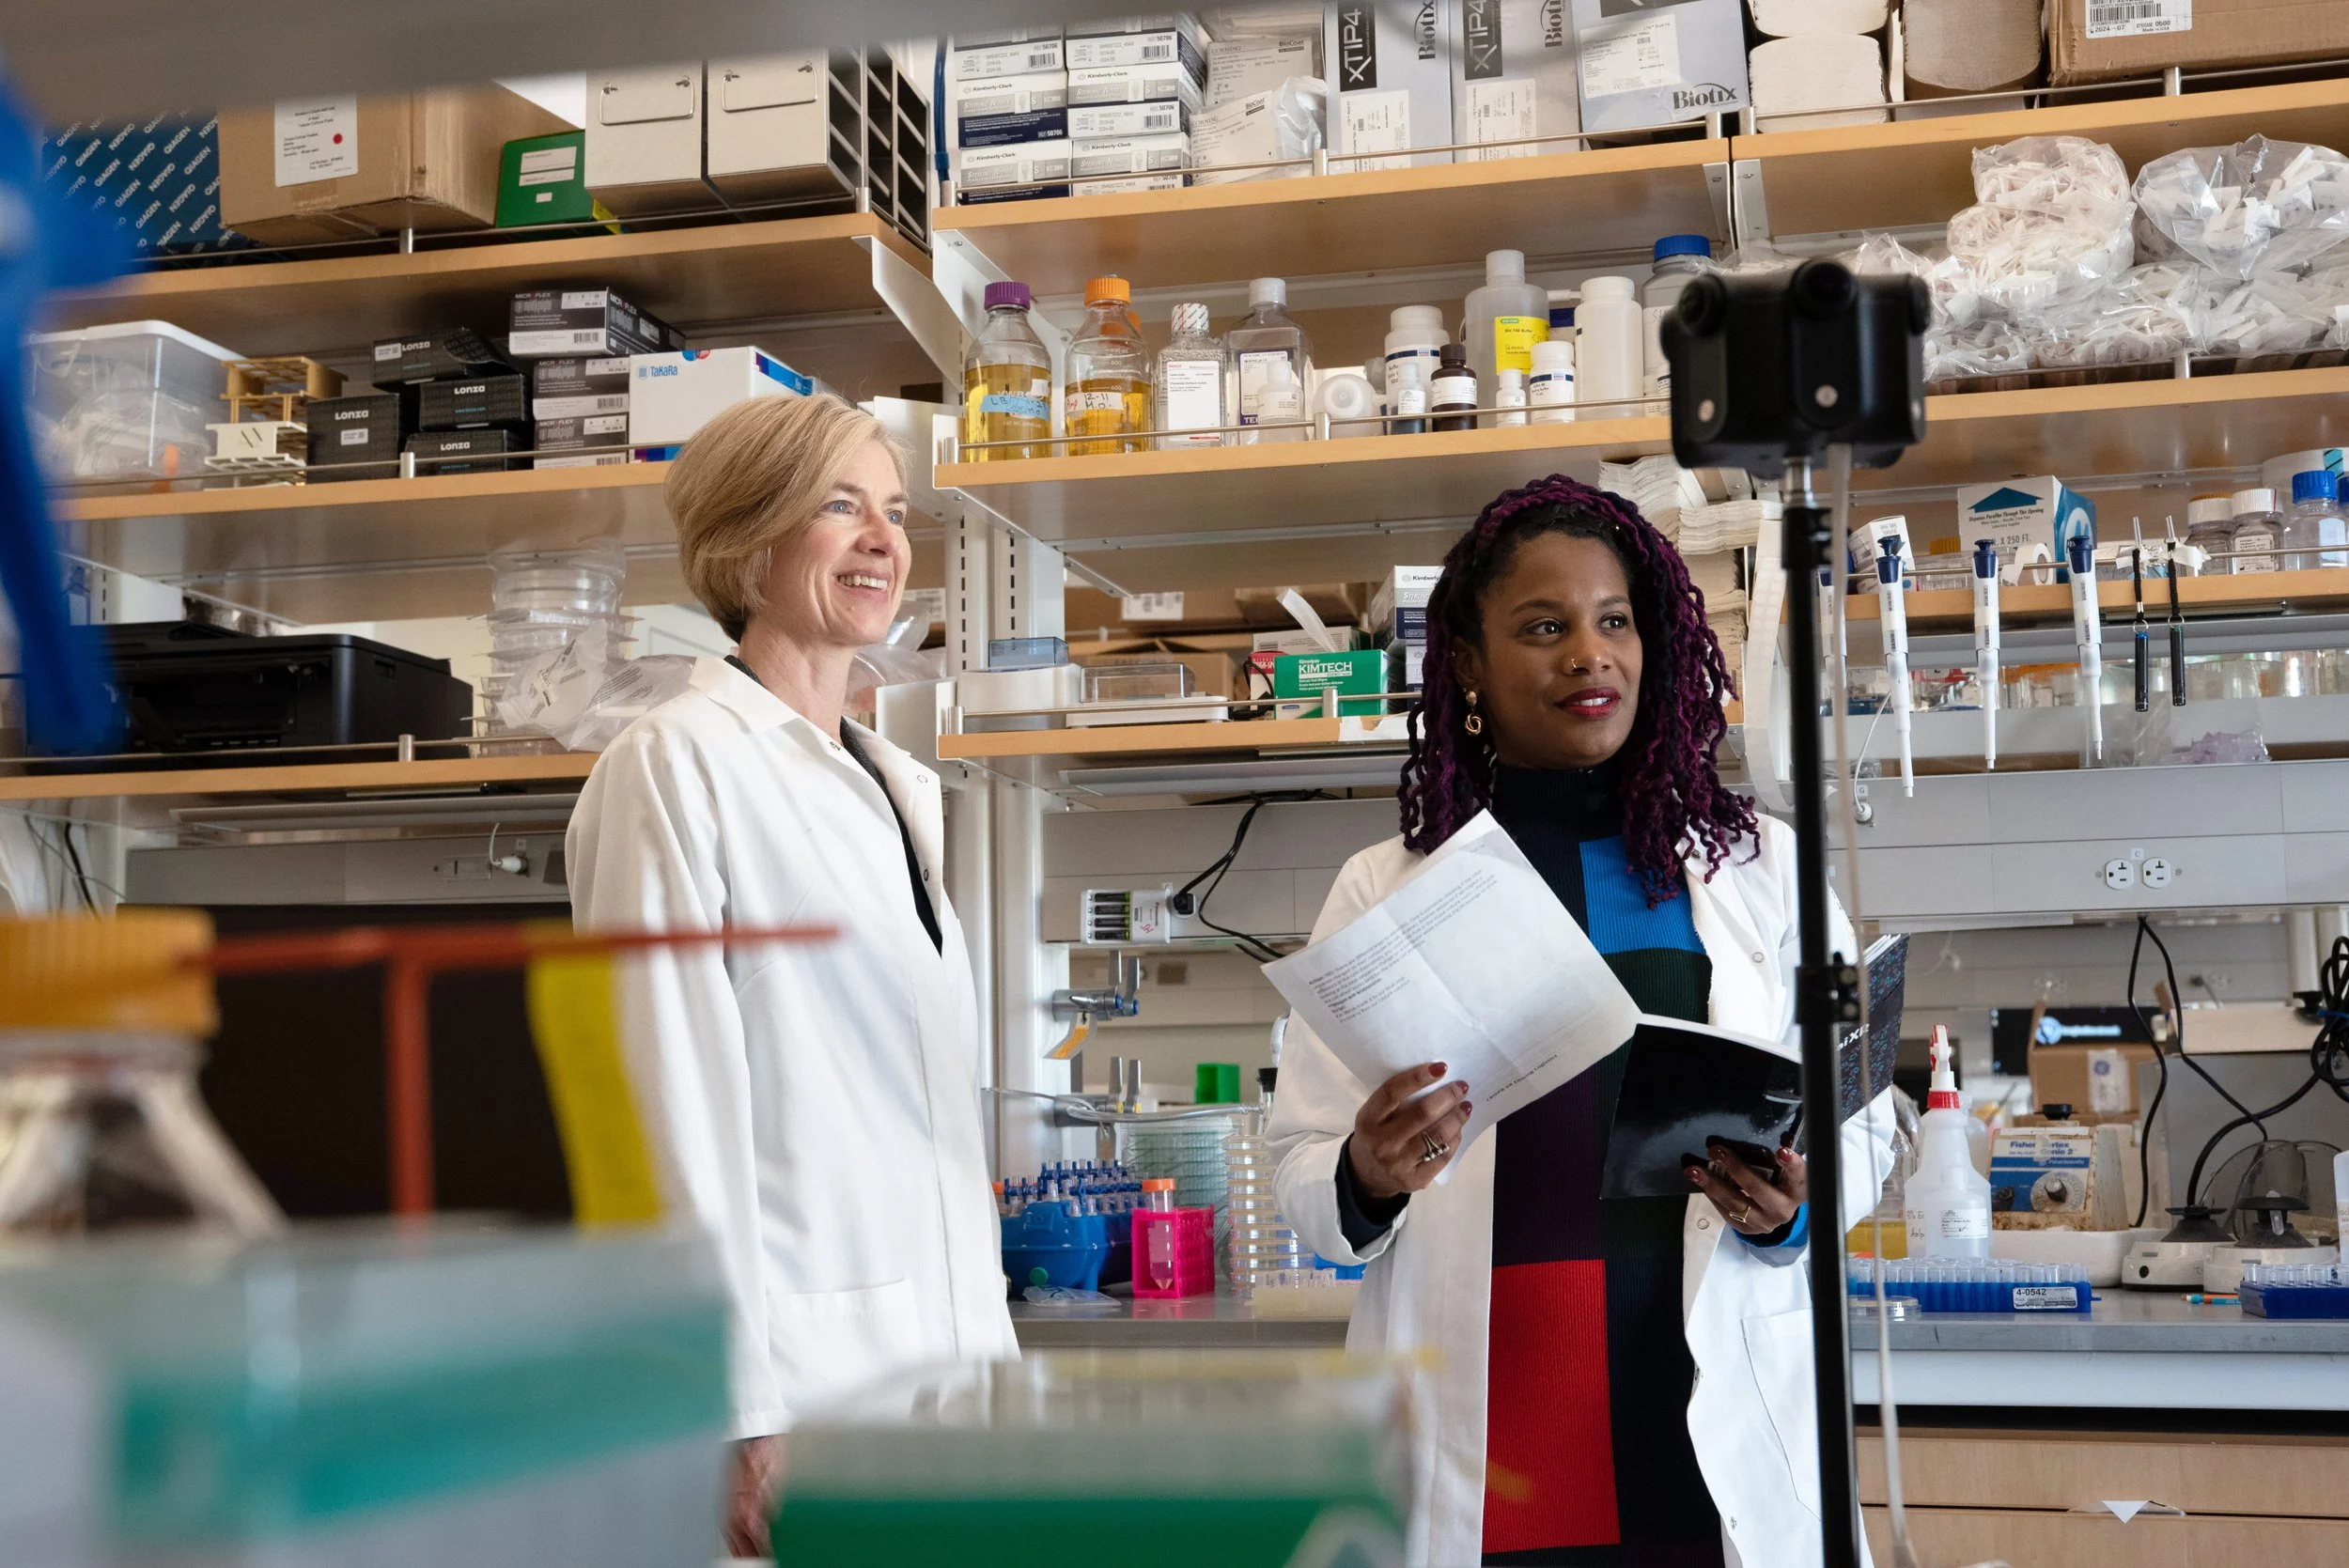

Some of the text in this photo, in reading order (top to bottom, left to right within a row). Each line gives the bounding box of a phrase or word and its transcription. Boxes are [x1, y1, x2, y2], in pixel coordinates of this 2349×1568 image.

[1414, 0, 1436, 60] Biotix
[1469, 0, 1497, 71] XTIP4
[1541, 0, 1563, 48] Bioti
[1344, 8, 1372, 83] XTIP4
[1246, 98, 1266, 110] BioCoat
[1672, 85, 1737, 110] Biotix
[109, 123, 135, 150] QIAGEN
[163, 126, 191, 154] QIAGEN
[1091, 142, 1131, 150] Kimberly-Clark
[75, 139, 101, 167] QIAGEN
[129, 143, 155, 171] QIAGEN
[184, 147, 211, 175] QIAGEN
[976, 152, 1016, 161] Kimberly-Clark
[95, 159, 121, 187] QIAGEN
[148, 163, 176, 192] QIAGEN
[115, 179, 141, 208] QIAGEN
[169, 184, 195, 213] QIAGEN
[136, 200, 162, 228] QIAGEN
[190, 205, 216, 233] QIAGEN
[1986, 512, 2002, 520] Parafilm
[2003, 510, 2018, 519] Through
[2007, 536, 2020, 545] 250
[2022, 534, 2031, 543] FT.
[1299, 661, 1352, 674] KIMTECH
[2016, 1288, 2046, 1296] 4-0542
